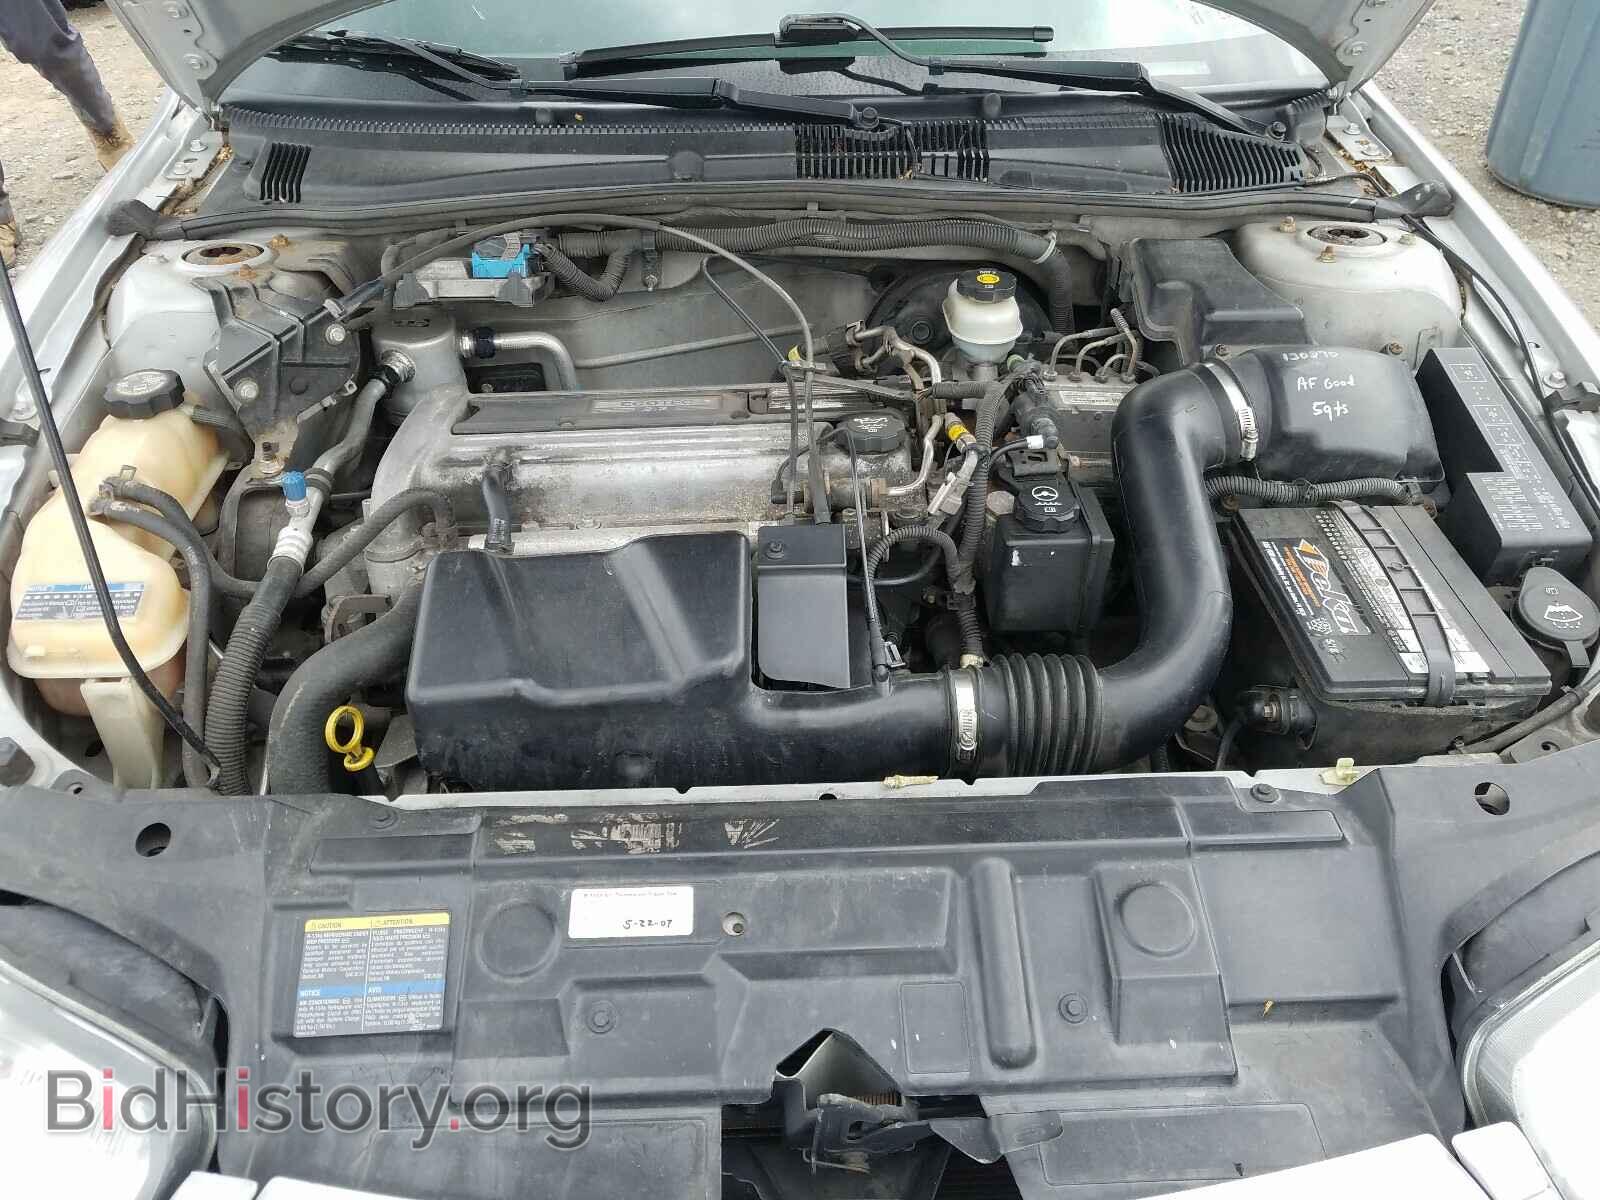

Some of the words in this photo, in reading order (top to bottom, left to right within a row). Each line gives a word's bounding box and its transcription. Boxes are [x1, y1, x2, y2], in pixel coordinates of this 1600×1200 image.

[1297, 376, 1318, 392] AF
[1324, 374, 1355, 390] Good
[622, 919, 673, 930] 5-22-07
